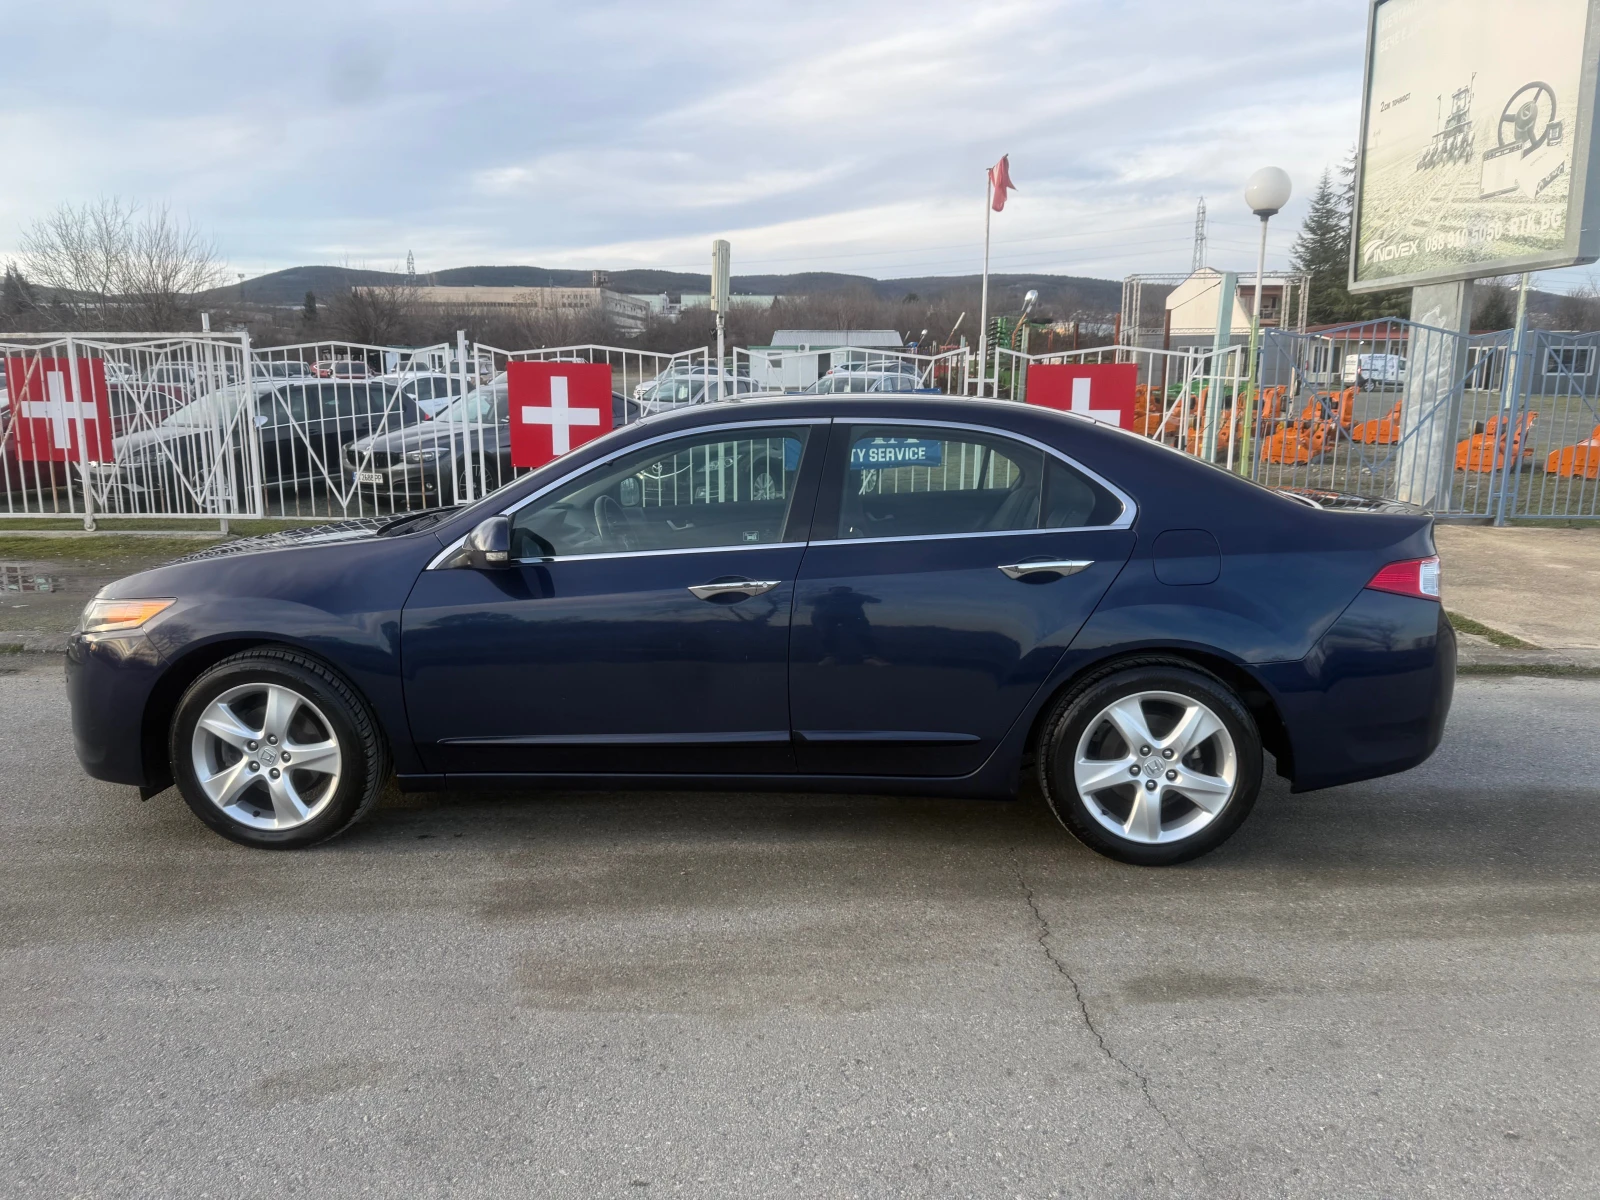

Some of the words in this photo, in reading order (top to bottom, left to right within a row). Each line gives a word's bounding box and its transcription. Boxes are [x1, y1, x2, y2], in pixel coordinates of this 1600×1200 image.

[1373, 239, 1420, 263] INOVEX
[1425, 234, 1445, 253] 088
[1470, 219, 1503, 243] 5050
[869, 447, 926, 462] SERVICE
